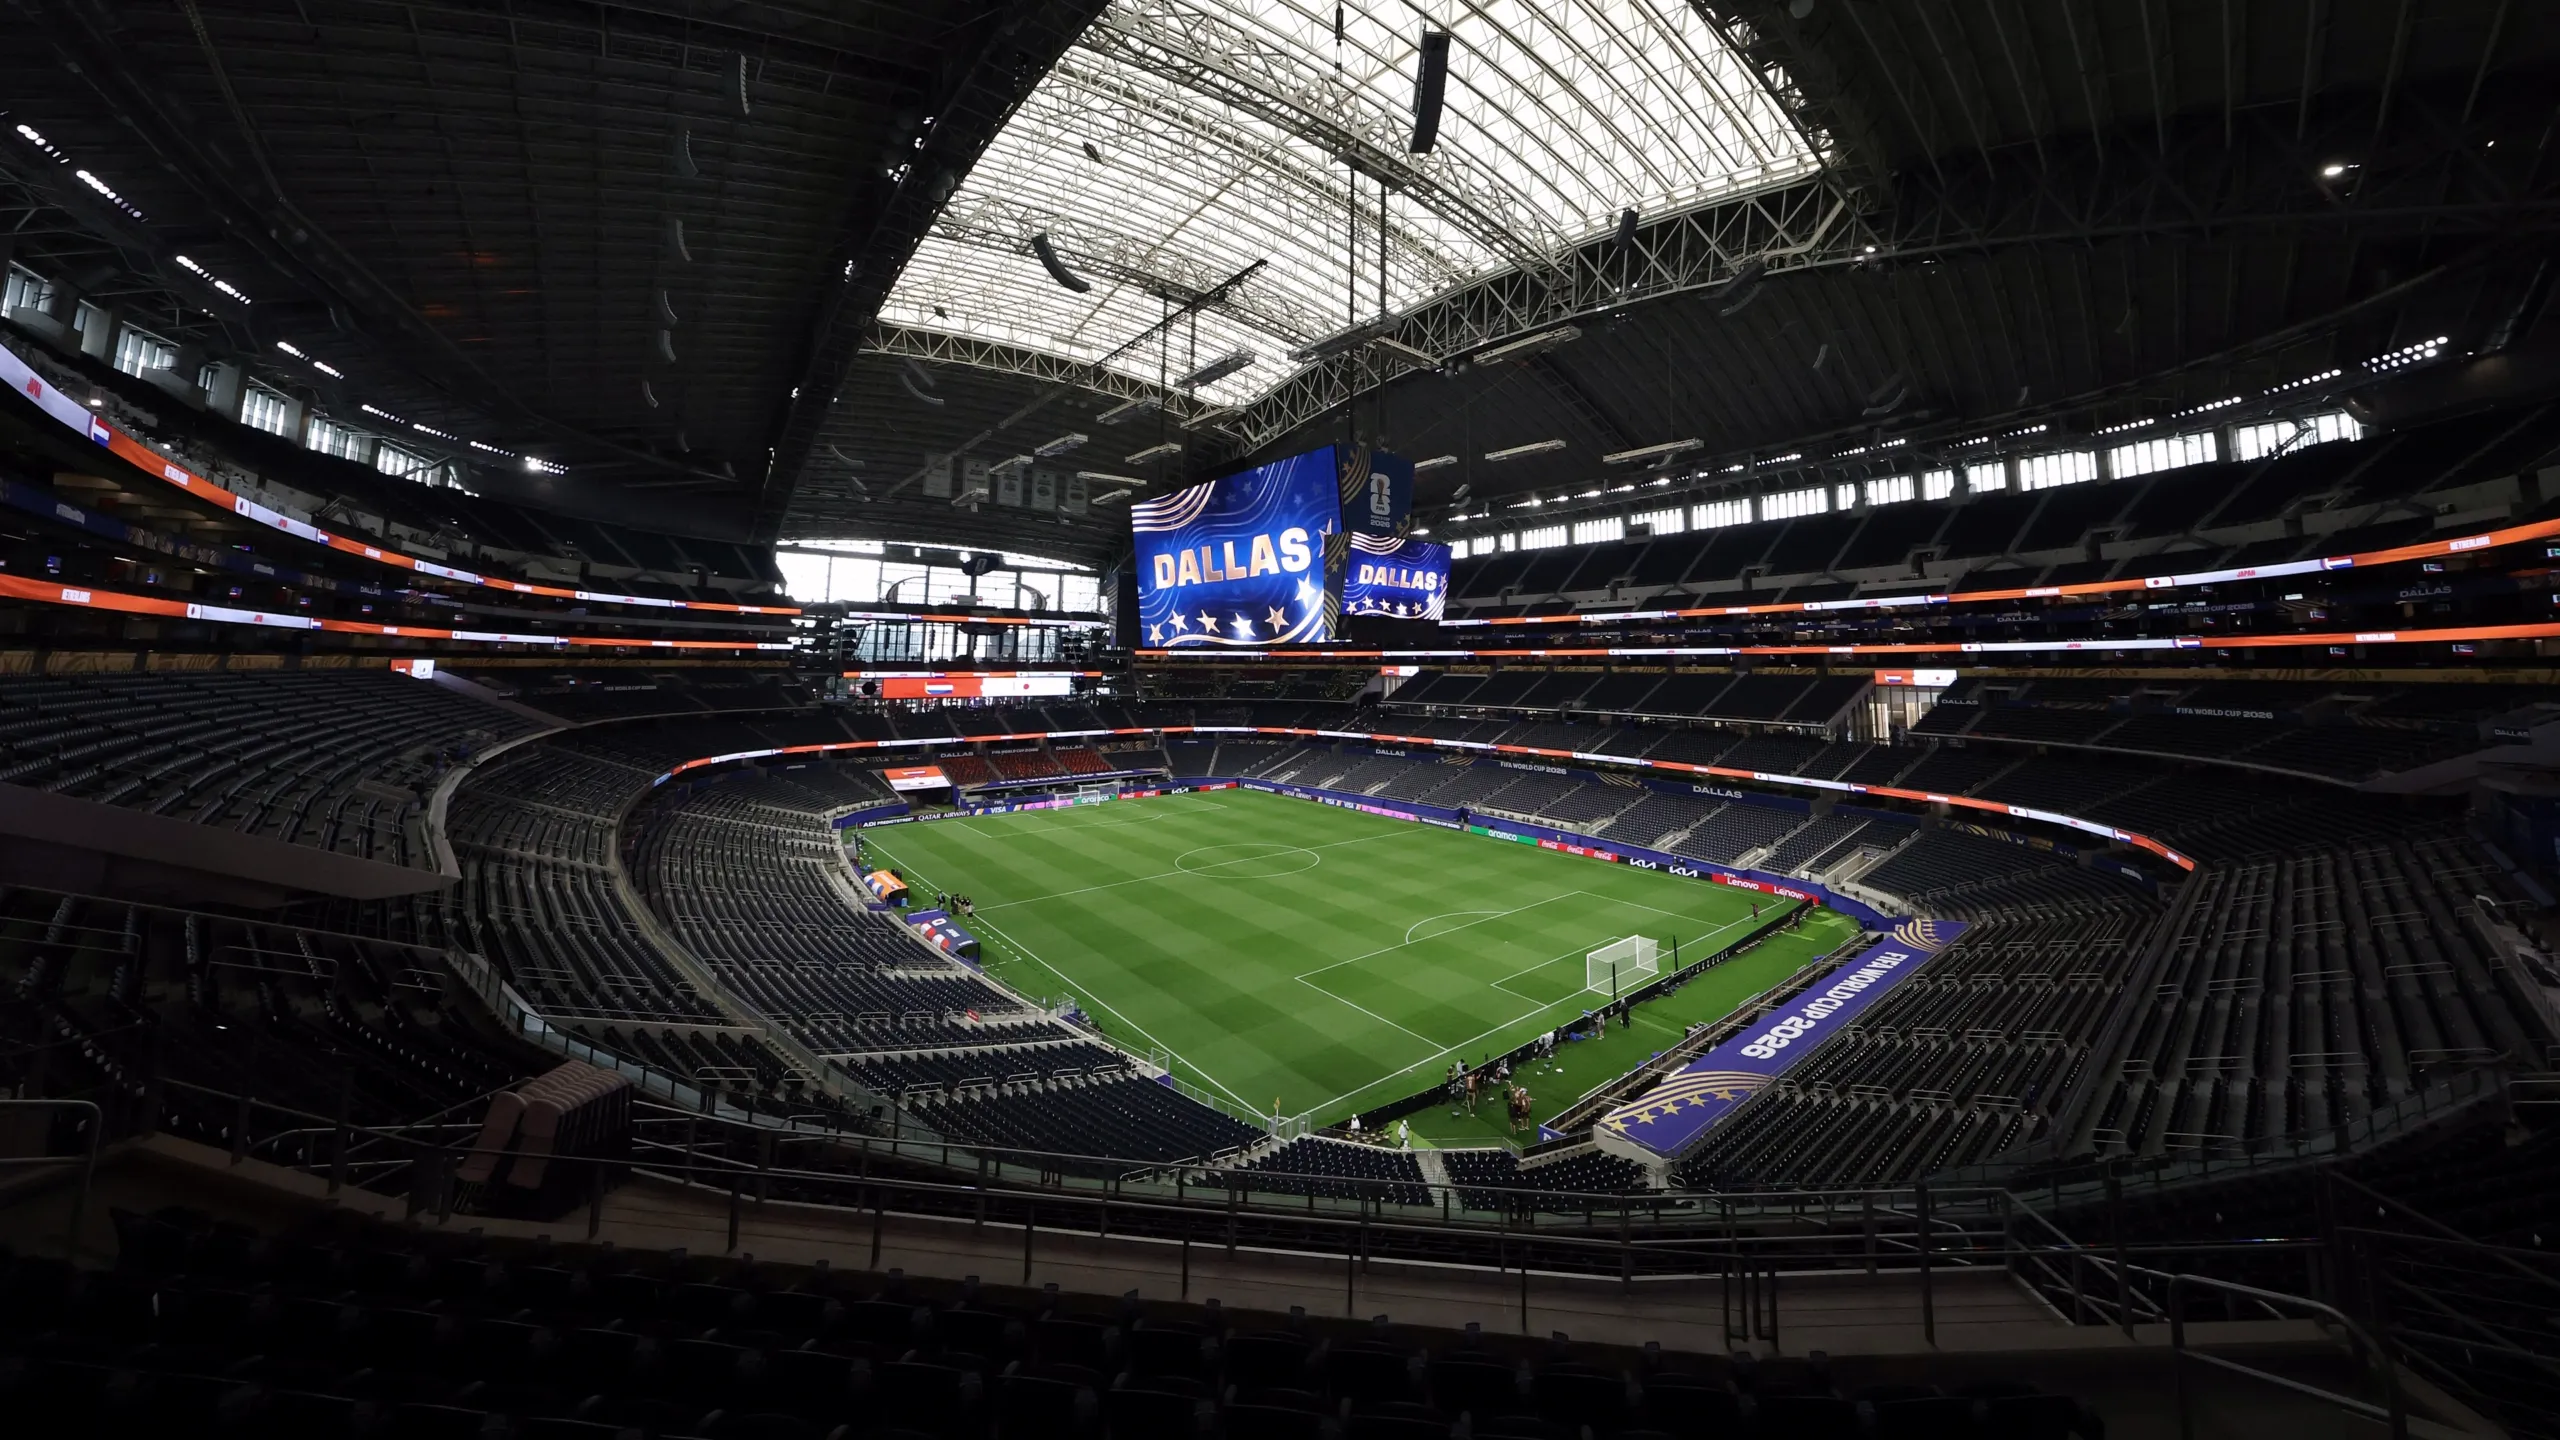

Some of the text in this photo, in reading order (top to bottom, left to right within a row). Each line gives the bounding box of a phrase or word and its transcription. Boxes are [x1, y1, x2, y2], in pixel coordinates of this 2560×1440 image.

[1371, 520, 1390, 528] 2026
[2449, 536, 2490, 550] NETHERLANDS
[1154, 527, 1311, 590] DALLAS
[1359, 564, 1437, 591] DALLAS
[2236, 570, 2256, 578] JAPAN
[361, 586, 381, 595] DALLAS
[2400, 586, 2452, 597] DALLAS
[2194, 708, 2223, 716] WORLD
[2243, 711, 2273, 719] 2026
[2495, 729, 2530, 737] DALLAS
[1375, 748, 1406, 757] DALLAS
[1500, 761, 1567, 775] FIFA WORLD CUP 2026
[1693, 785, 1743, 799] DALLAS
[1081, 795, 1109, 804] aramco
[1344, 801, 1354, 809] VISA
[943, 810, 970, 818] AIRWAYS
[990, 806, 1006, 814] VISA
[877, 817, 914, 825] PREDICTSTREET
[1488, 829, 1518, 842] aramco
[1727, 877, 1759, 890] Lenovo
[1774, 886, 1805, 900] Lenovo
[1740, 951, 1910, 1060] FIFA WORLD CUP 2026
